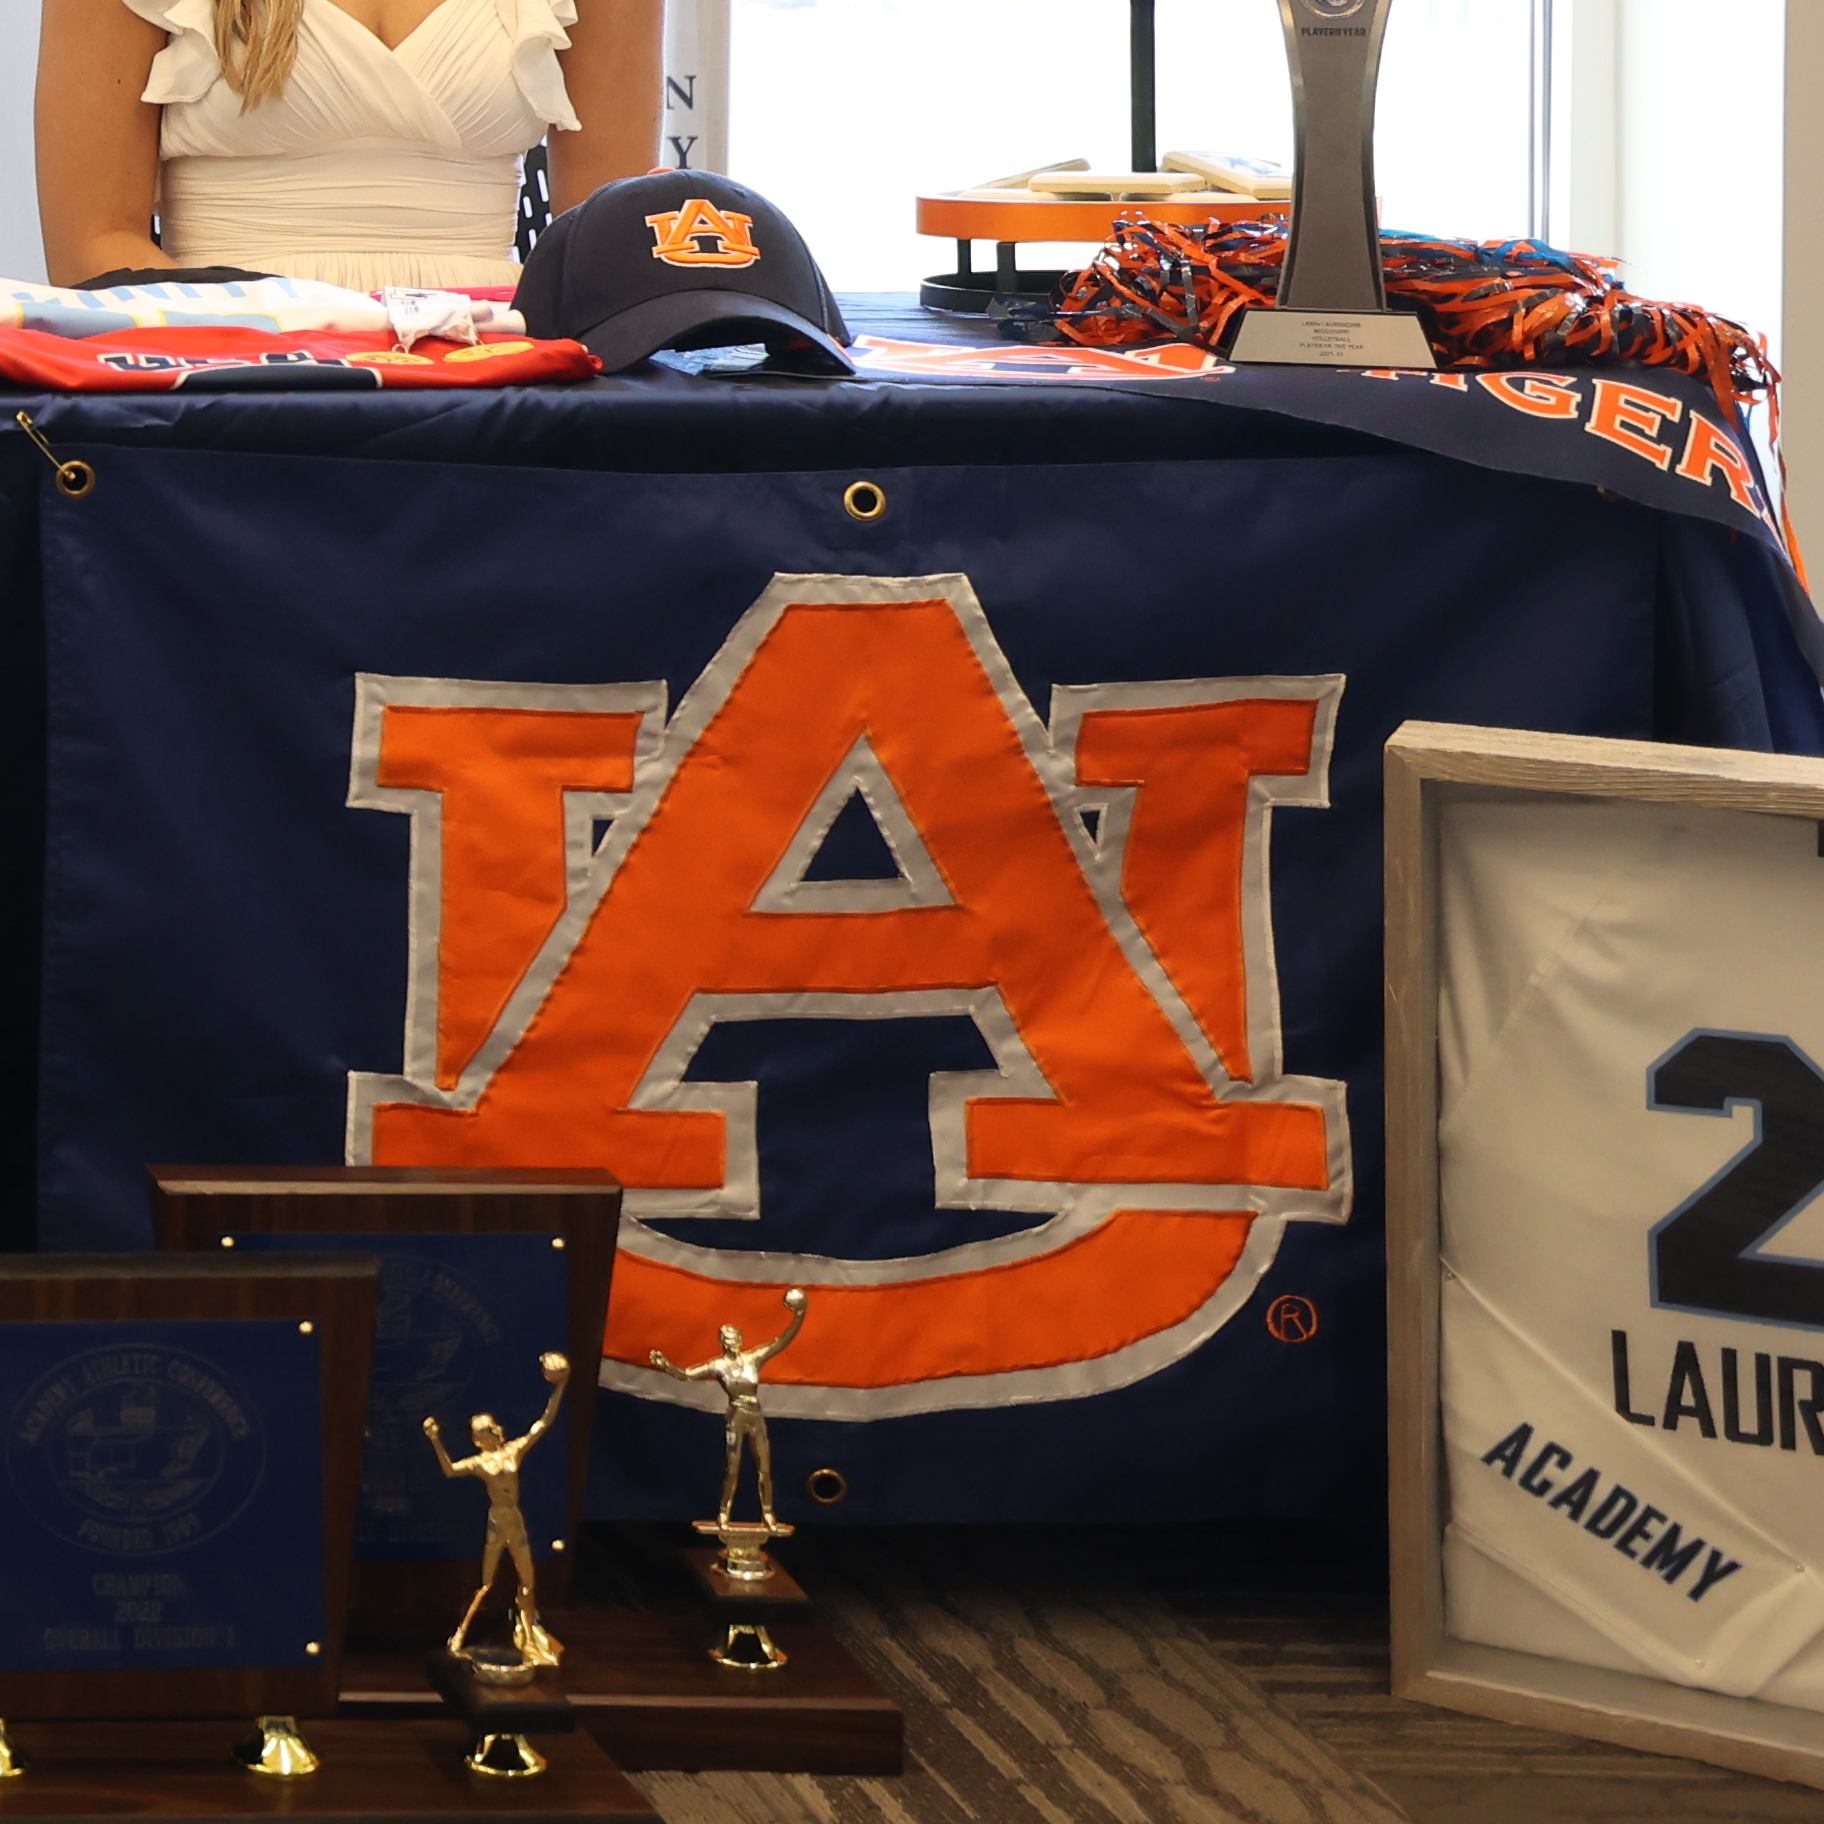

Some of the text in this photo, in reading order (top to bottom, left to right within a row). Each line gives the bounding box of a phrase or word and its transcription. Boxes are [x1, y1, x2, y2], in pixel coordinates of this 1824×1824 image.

[347, 572, 1351, 1422] AU
[81, 1352, 162, 1386] ATHLETIC
[1480, 1421, 1743, 1604] ACADEMY
[92, 1573, 188, 1597] CHAMPION
[115, 1600, 163, 1623] 2022
[43, 1626, 122, 1651] OVERALL
[134, 1626, 217, 1650] DIVISION
